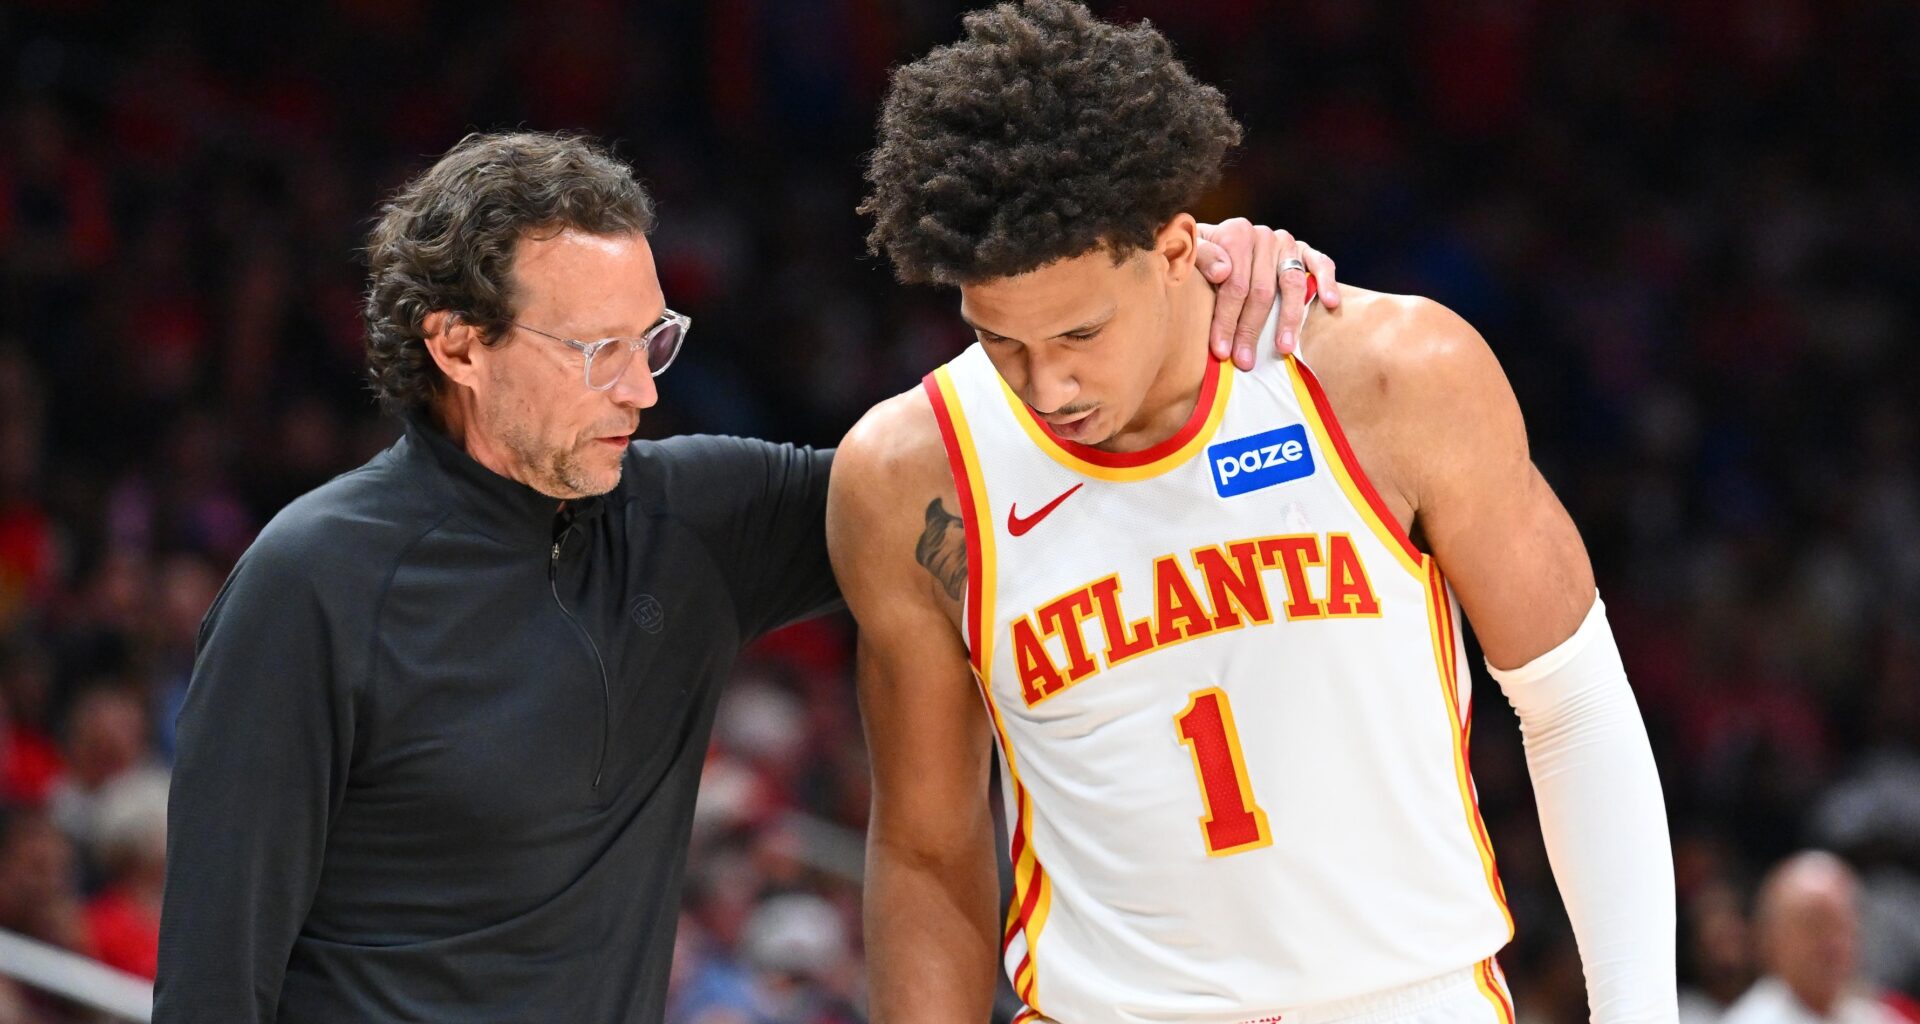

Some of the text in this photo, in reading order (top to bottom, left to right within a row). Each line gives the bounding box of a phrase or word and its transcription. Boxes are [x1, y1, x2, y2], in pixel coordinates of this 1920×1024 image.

[1216, 440, 1303, 486] paze
[1010, 532, 1382, 709] ATLANTA
[1172, 686, 1274, 858] 1
